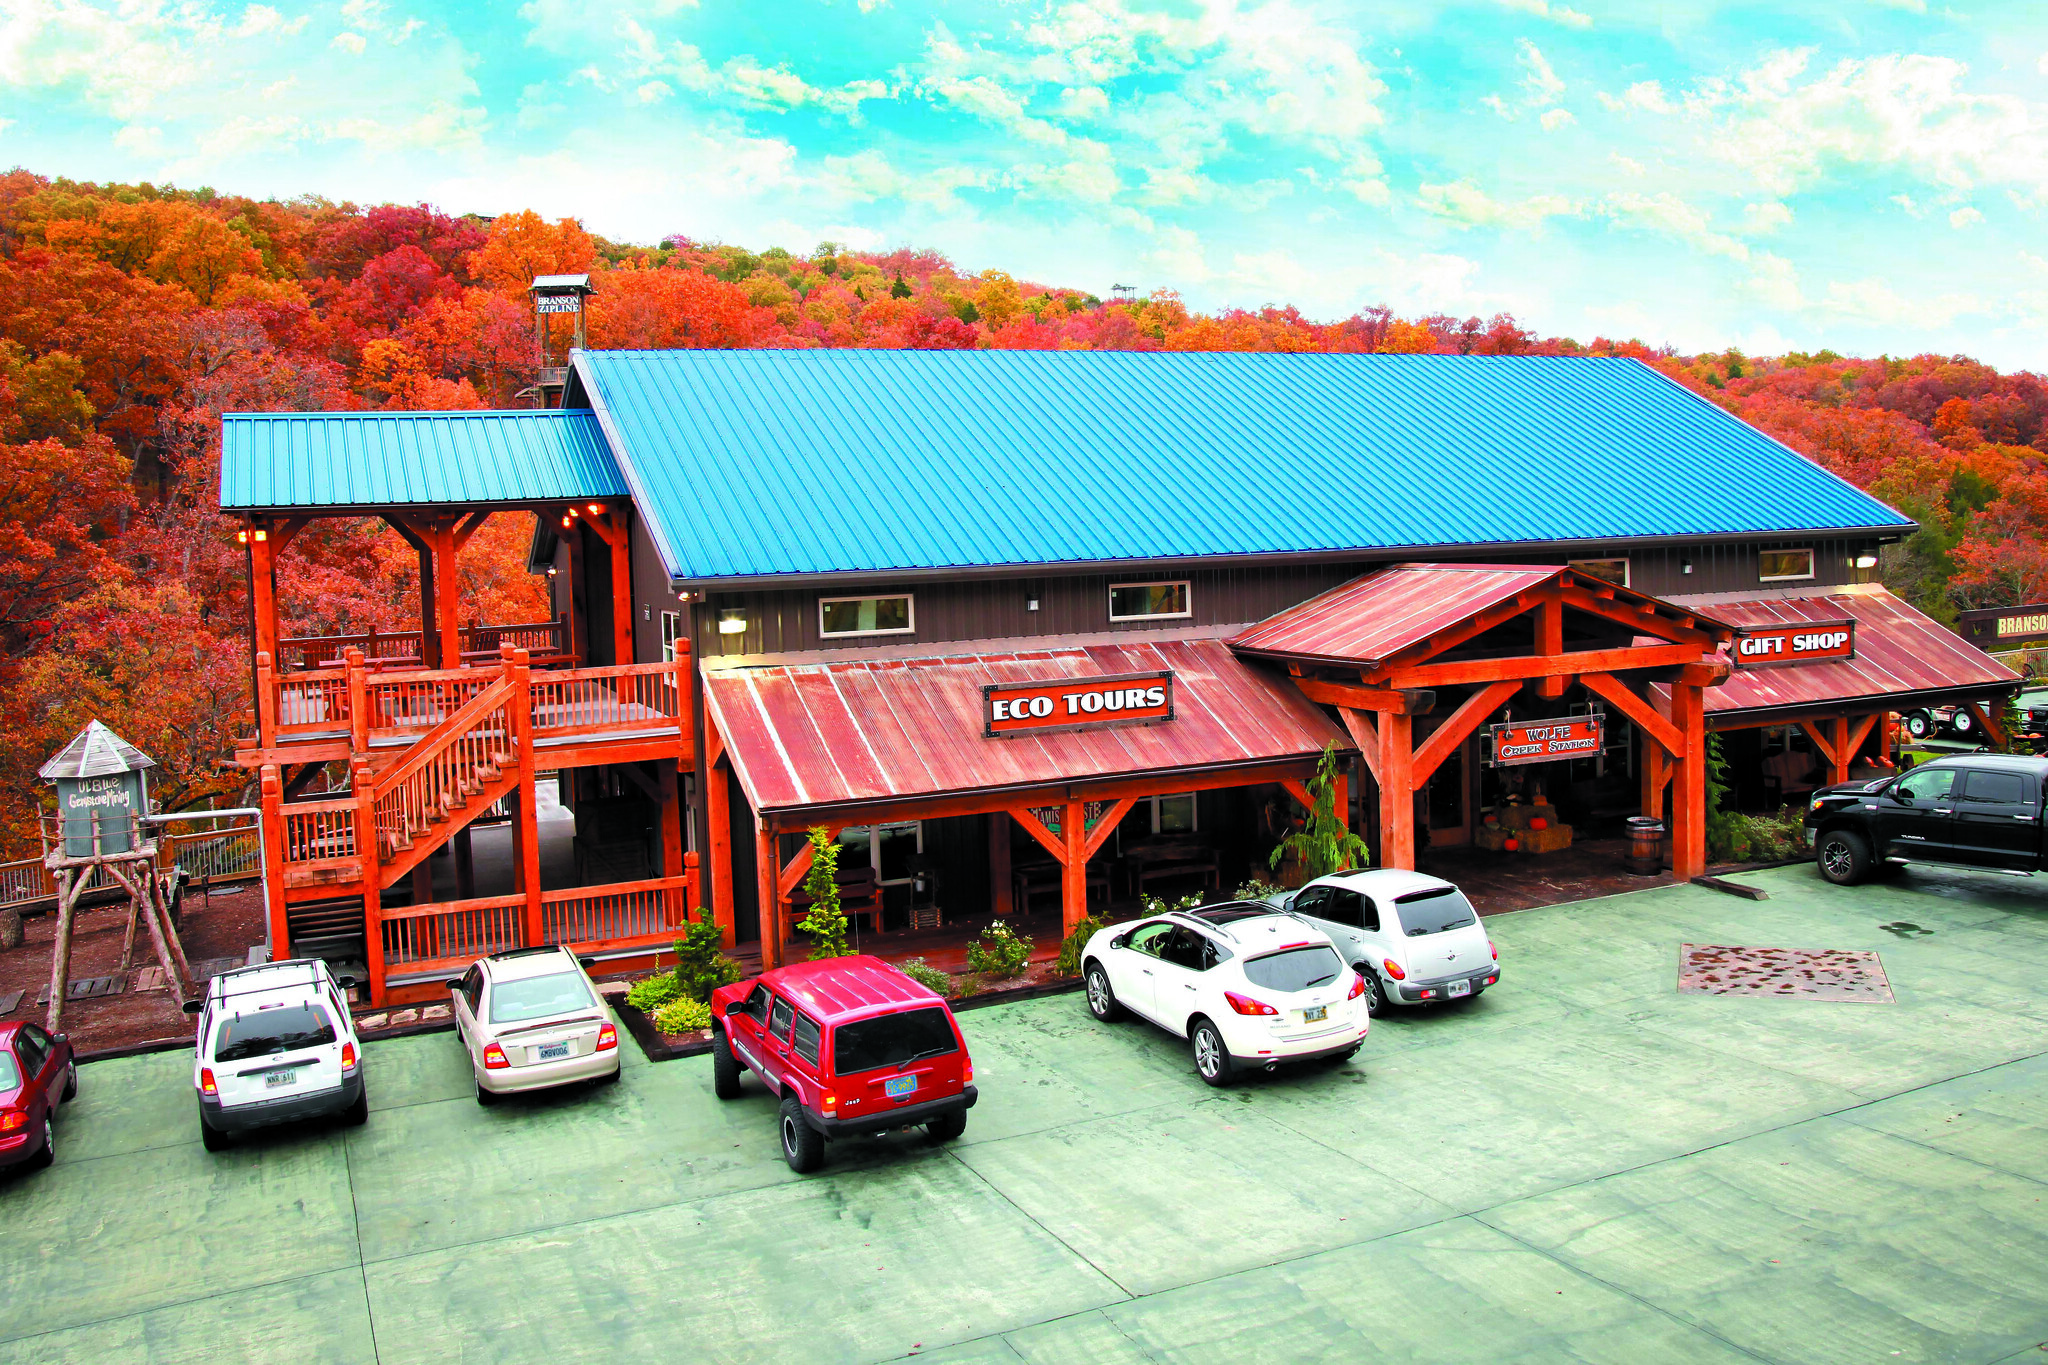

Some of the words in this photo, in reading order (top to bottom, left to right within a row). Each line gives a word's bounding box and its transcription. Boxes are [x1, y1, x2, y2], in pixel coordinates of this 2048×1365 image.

[538, 296, 579, 305] BRANSON
[538, 304, 579, 313] ZIPLINE
[1998, 614, 2048, 634] BRANSO
[1740, 636, 1786, 655] GIFT
[1792, 632, 1849, 652] SHOP
[992, 696, 1054, 722] ECO
[1061, 686, 1166, 715] TOURS
[1526, 725, 1572, 742] WOLFE
[1501, 744, 1543, 758] CREEK
[1548, 738, 1596, 753] STATION
[844, 1098, 861, 1106] Jeep
